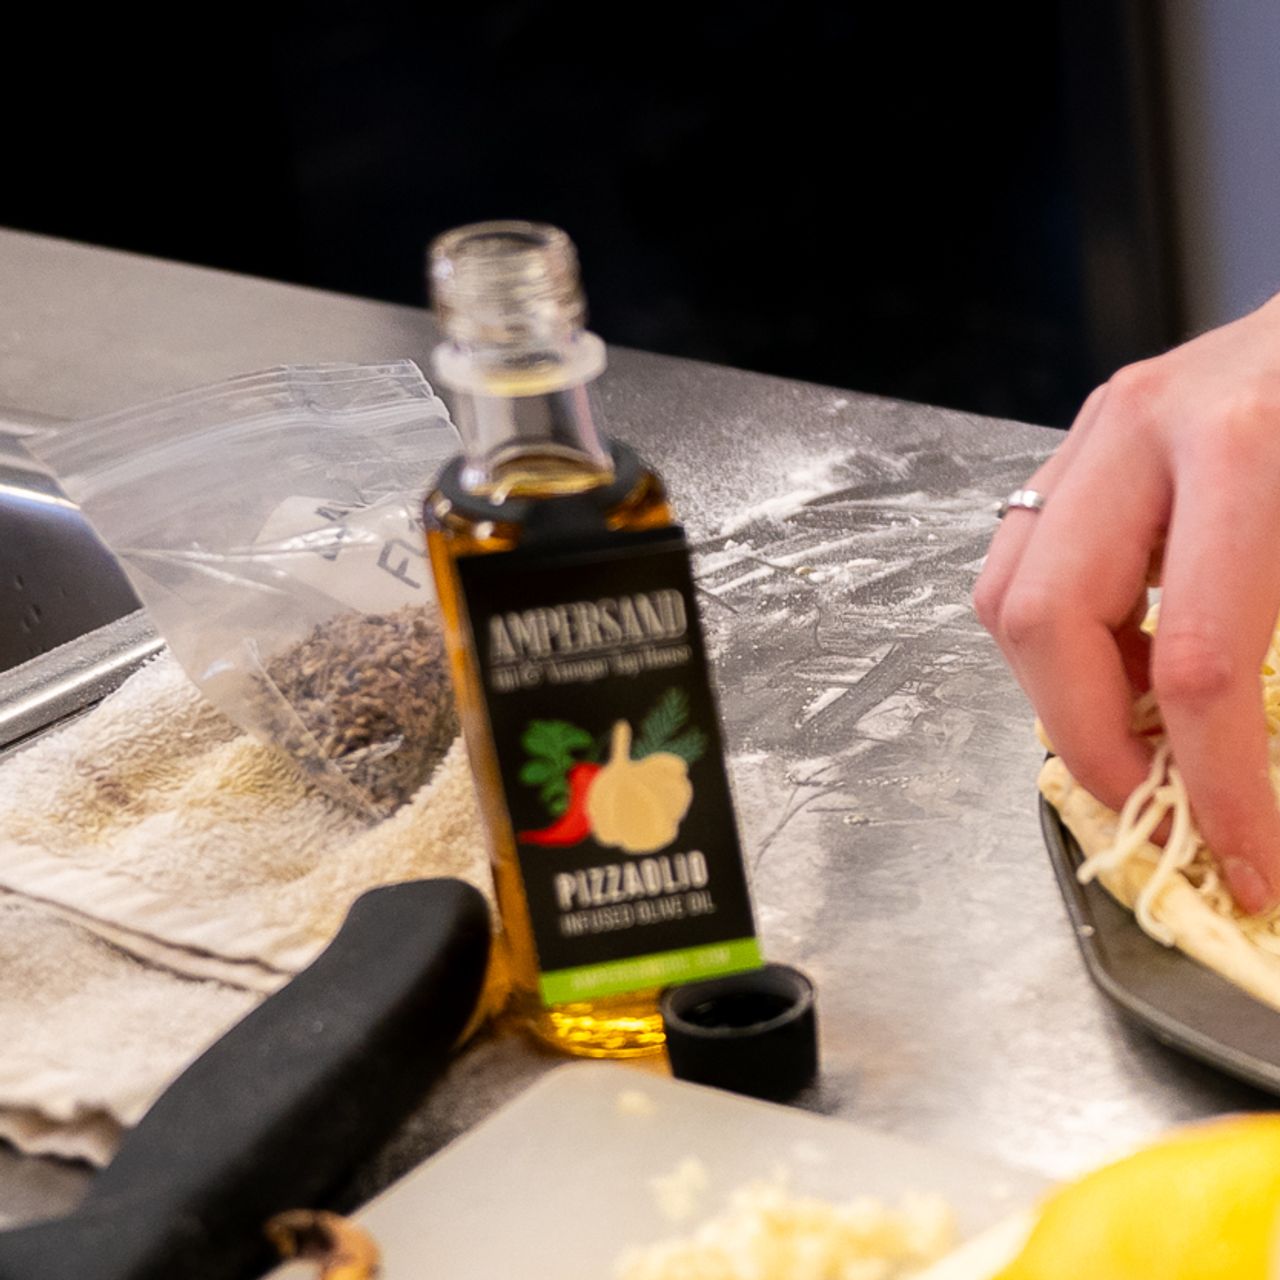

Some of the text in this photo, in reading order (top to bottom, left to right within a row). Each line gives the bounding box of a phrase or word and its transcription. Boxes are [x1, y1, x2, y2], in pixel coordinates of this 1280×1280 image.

[487, 588, 687, 664] AMPERSAND
[553, 850, 710, 911] PIZZAOLIO
[560, 889, 717, 937] INFUSED OLIVE OIL
